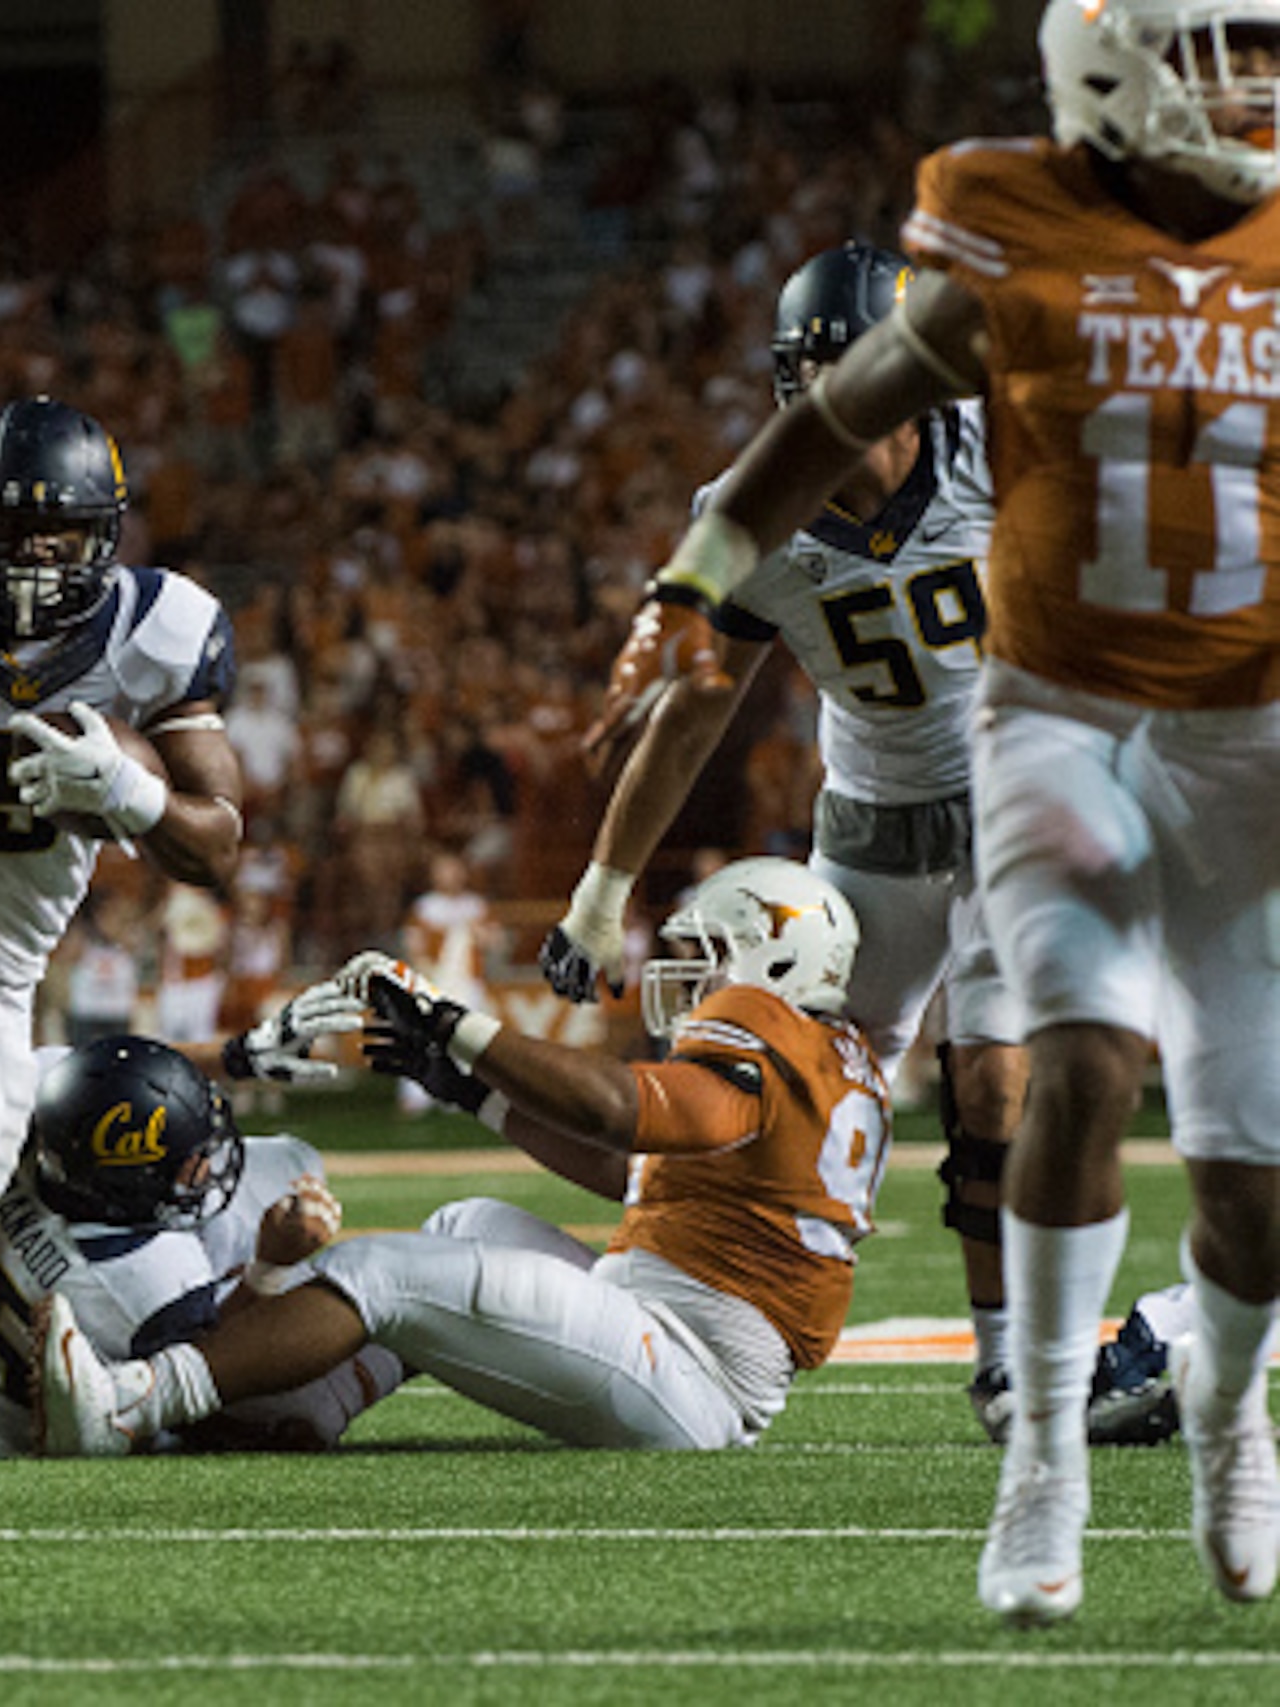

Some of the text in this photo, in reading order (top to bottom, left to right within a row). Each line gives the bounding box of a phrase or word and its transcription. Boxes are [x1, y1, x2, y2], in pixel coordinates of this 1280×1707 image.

[1077, 312, 1280, 398] TEXAS
[1077, 391, 1268, 616] 11
[820, 557, 988, 709] 59
[93, 1101, 170, 1166] Cal
